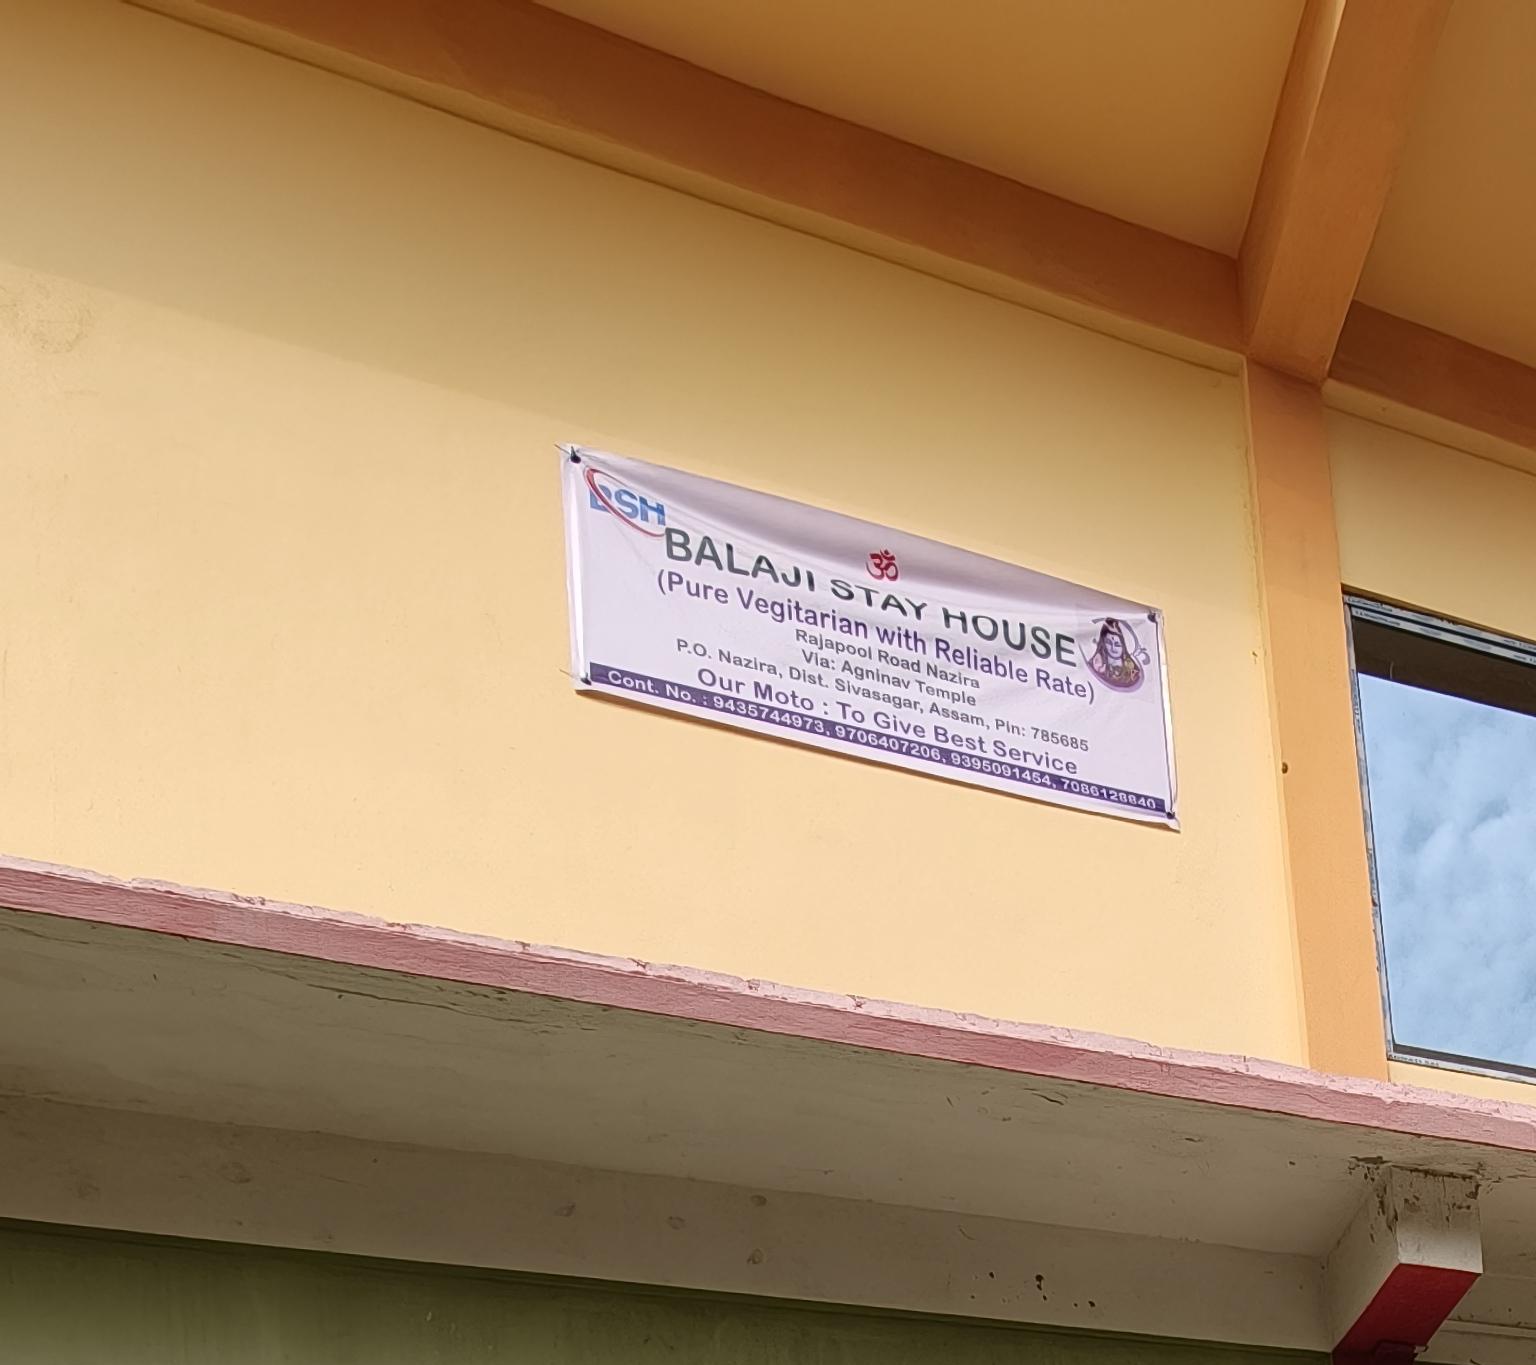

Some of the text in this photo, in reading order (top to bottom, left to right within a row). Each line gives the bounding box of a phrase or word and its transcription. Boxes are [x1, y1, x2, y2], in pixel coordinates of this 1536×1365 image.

[657, 569, 1095, 705] (Pure Vegitarian with Reliable Rate)
[665, 527, 1077, 667] BALAJI STAY HOUSE
[607, 669, 659, 694] Cont.
[665, 683, 697, 703] No.
[712, 695, 831, 737] 9435744973,
[676, 638, 1089, 752] P.O. Nazira, Dist. Sivasagar, Assam, Pin: 785685
[795, 628, 980, 690] Rajapool Road Nazira
[801, 649, 977, 707] Via: Agninav Temple
[697, 668, 746, 695] Our
[753, 681, 815, 712] Moto
[836, 701, 865, 724] To
[874, 710, 926, 739] Give
[934, 725, 986, 753] Best
[992, 739, 1078, 775] Service
